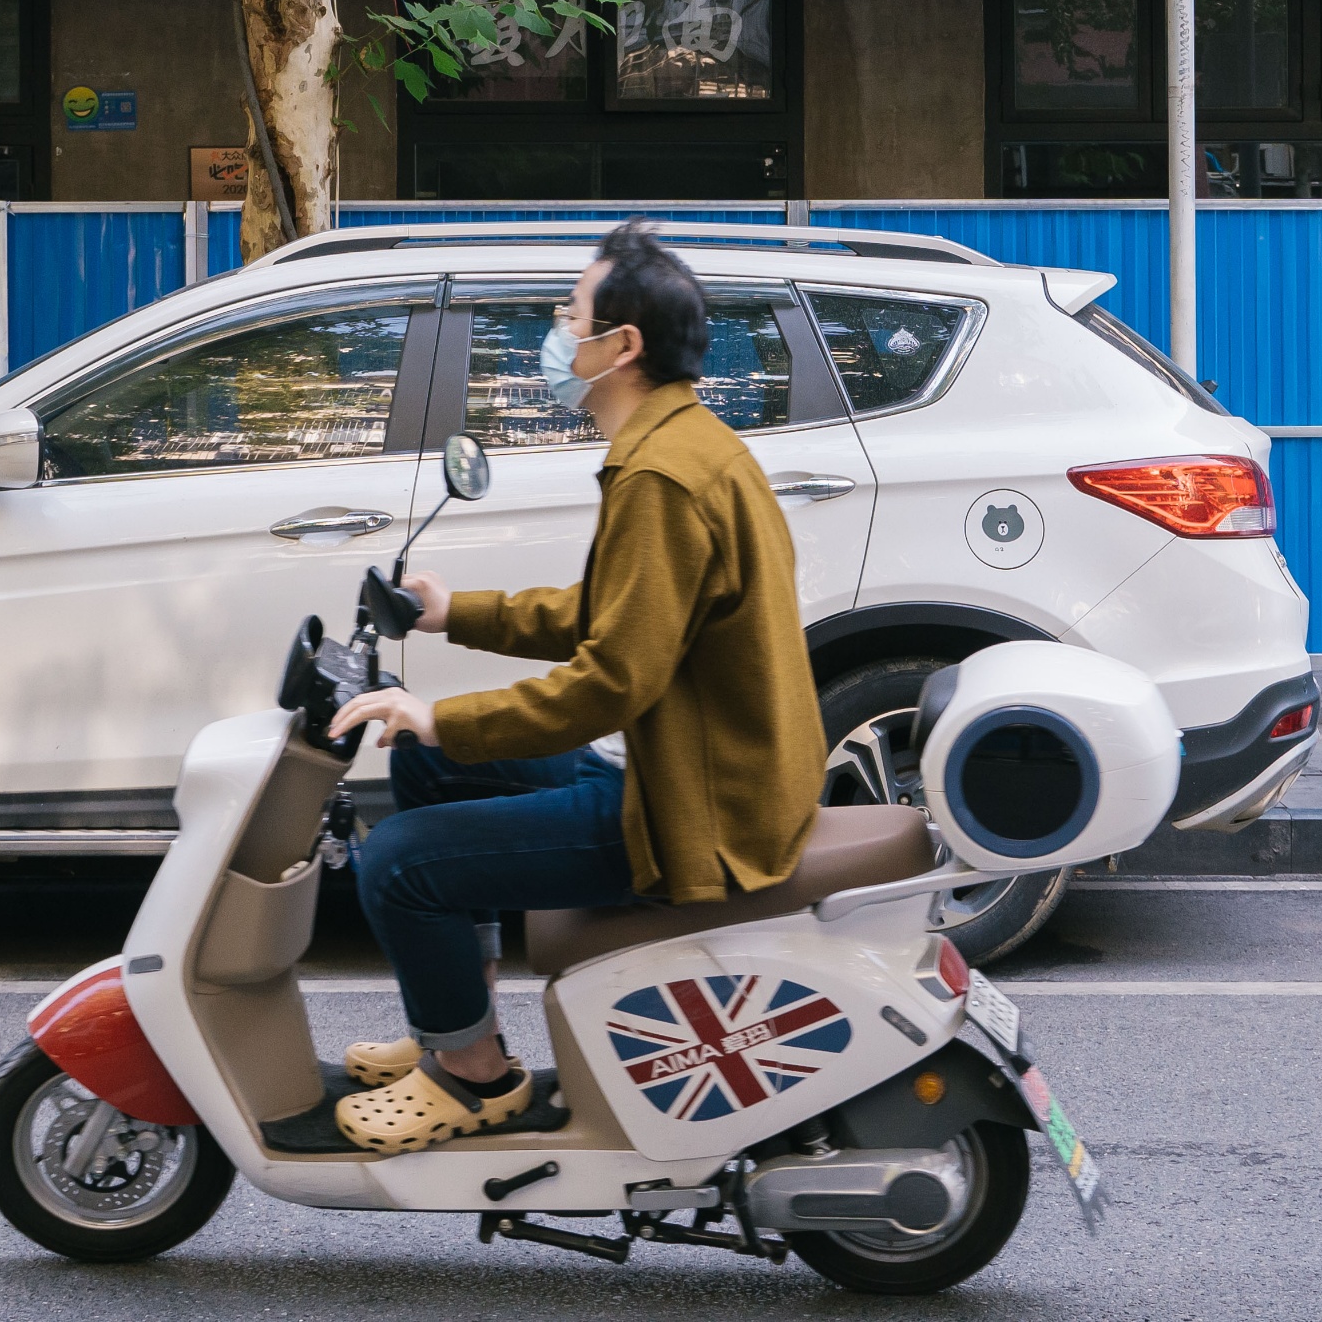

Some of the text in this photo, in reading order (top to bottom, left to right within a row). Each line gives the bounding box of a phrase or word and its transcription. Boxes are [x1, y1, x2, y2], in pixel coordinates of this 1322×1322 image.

[209, 163, 248, 180] 必吃
[650, 1023, 773, 1079] AIMA 爱玛
